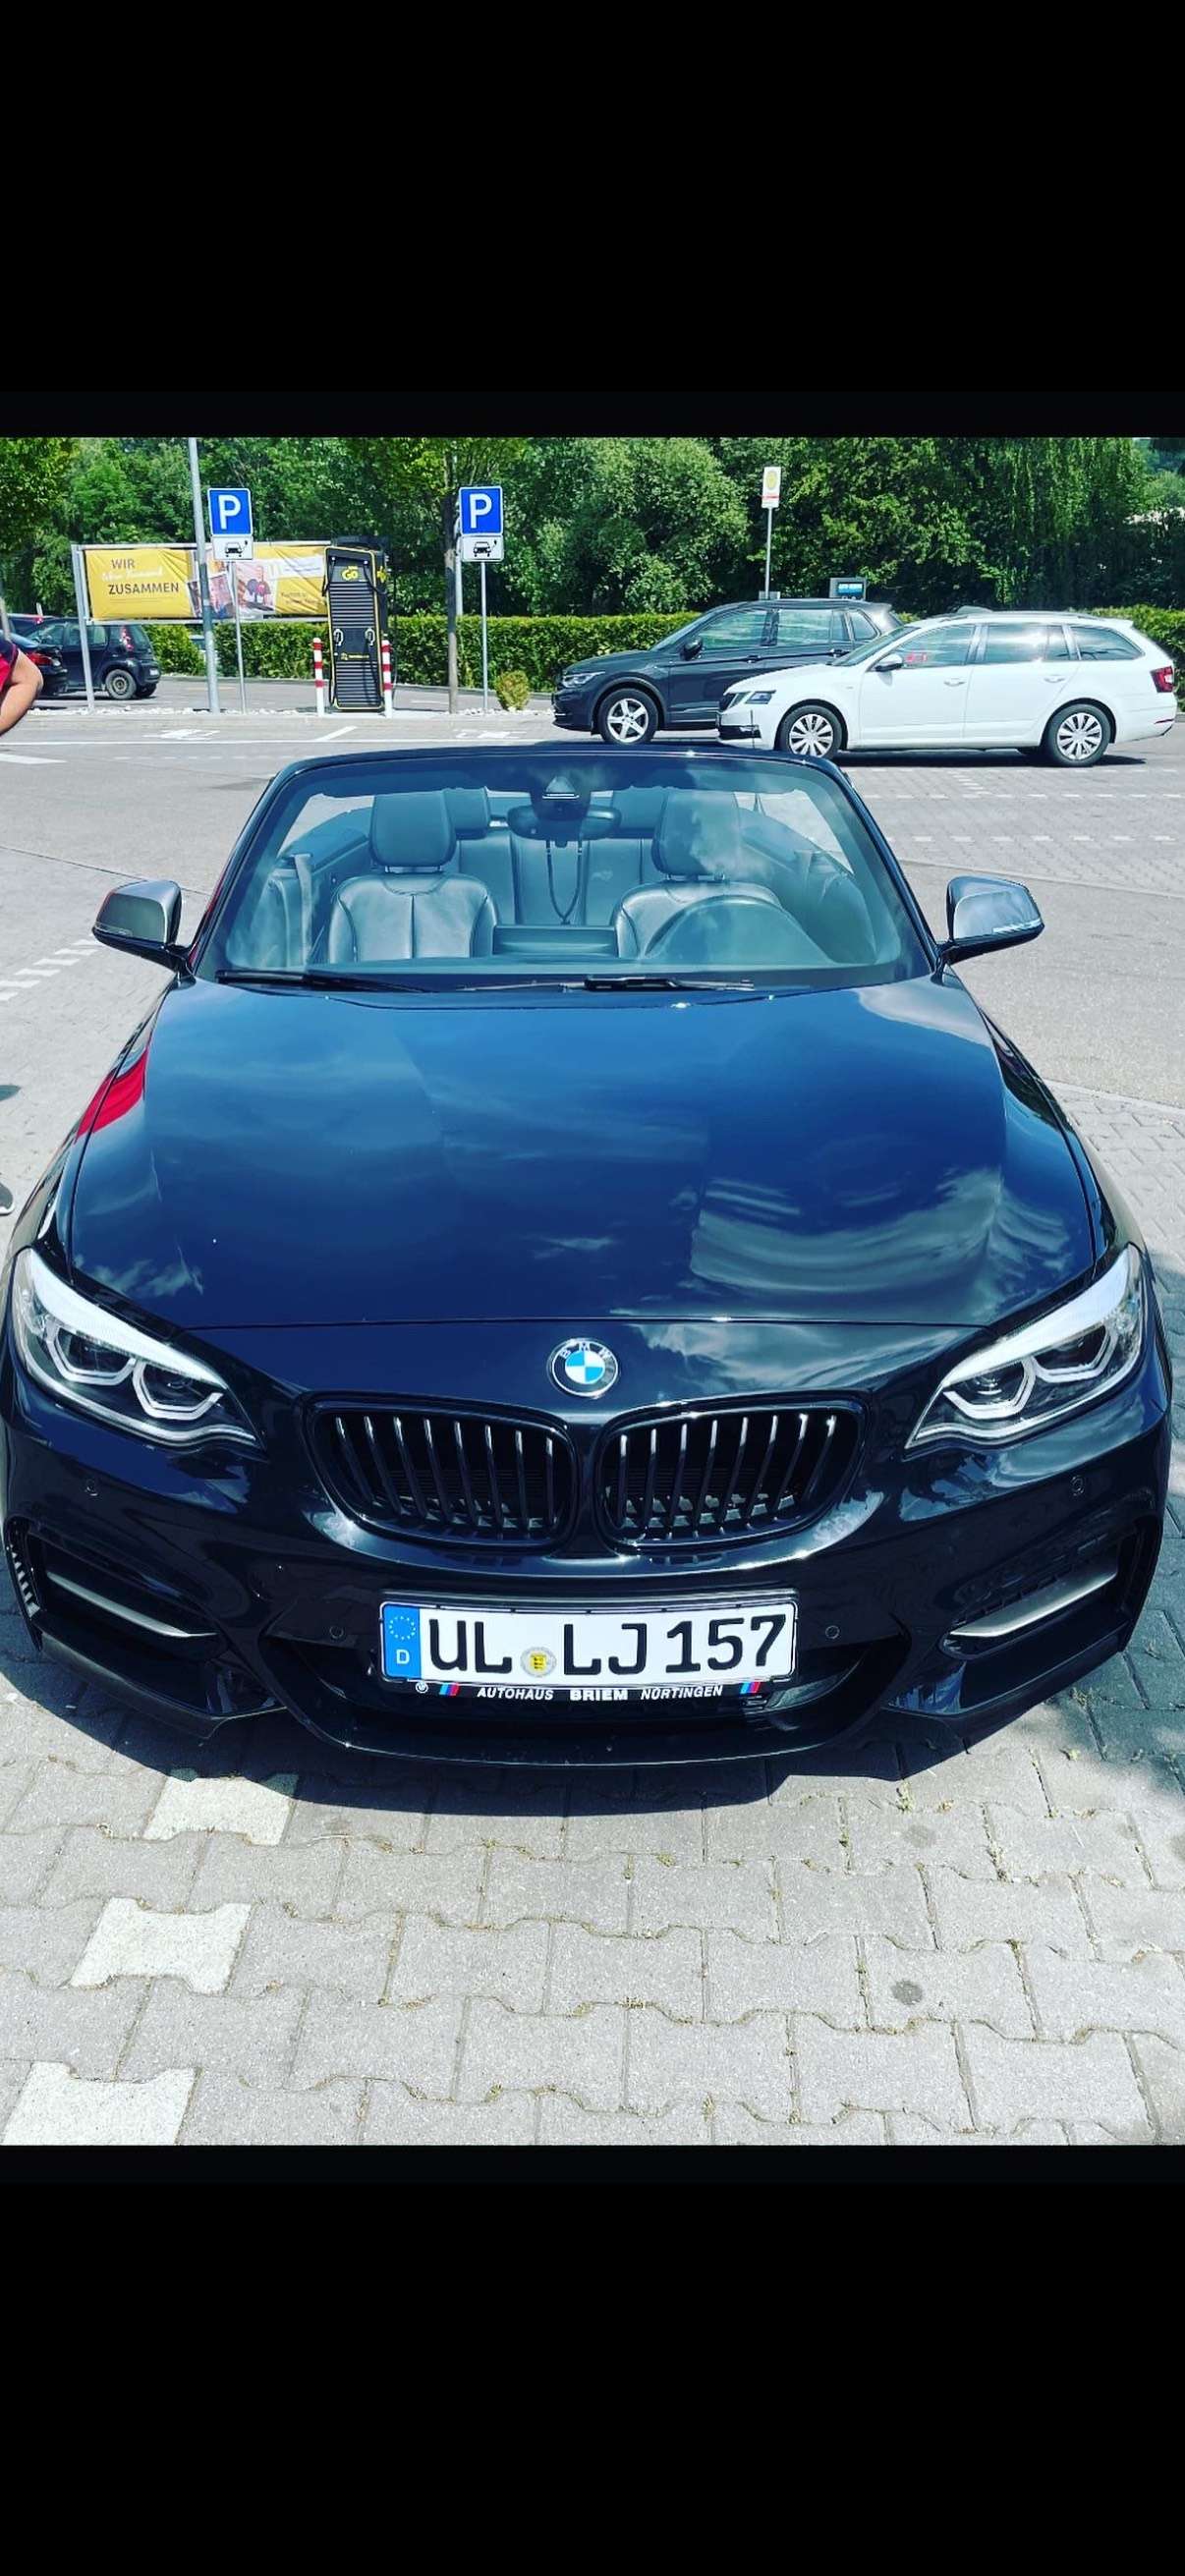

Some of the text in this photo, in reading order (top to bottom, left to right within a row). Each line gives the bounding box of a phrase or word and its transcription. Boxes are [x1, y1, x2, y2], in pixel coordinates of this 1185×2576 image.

[218, 494, 242, 530] P
[470, 493, 492, 529] P
[111, 558, 136, 570] WIR
[108, 582, 179, 595] ZUSAMMEN
[429, 1614, 786, 1676] UL LJ 157
[396, 1650, 410, 1664] D
[477, 1687, 554, 1701] AUTOHAUS
[570, 1689, 629, 1702] BRIEM
